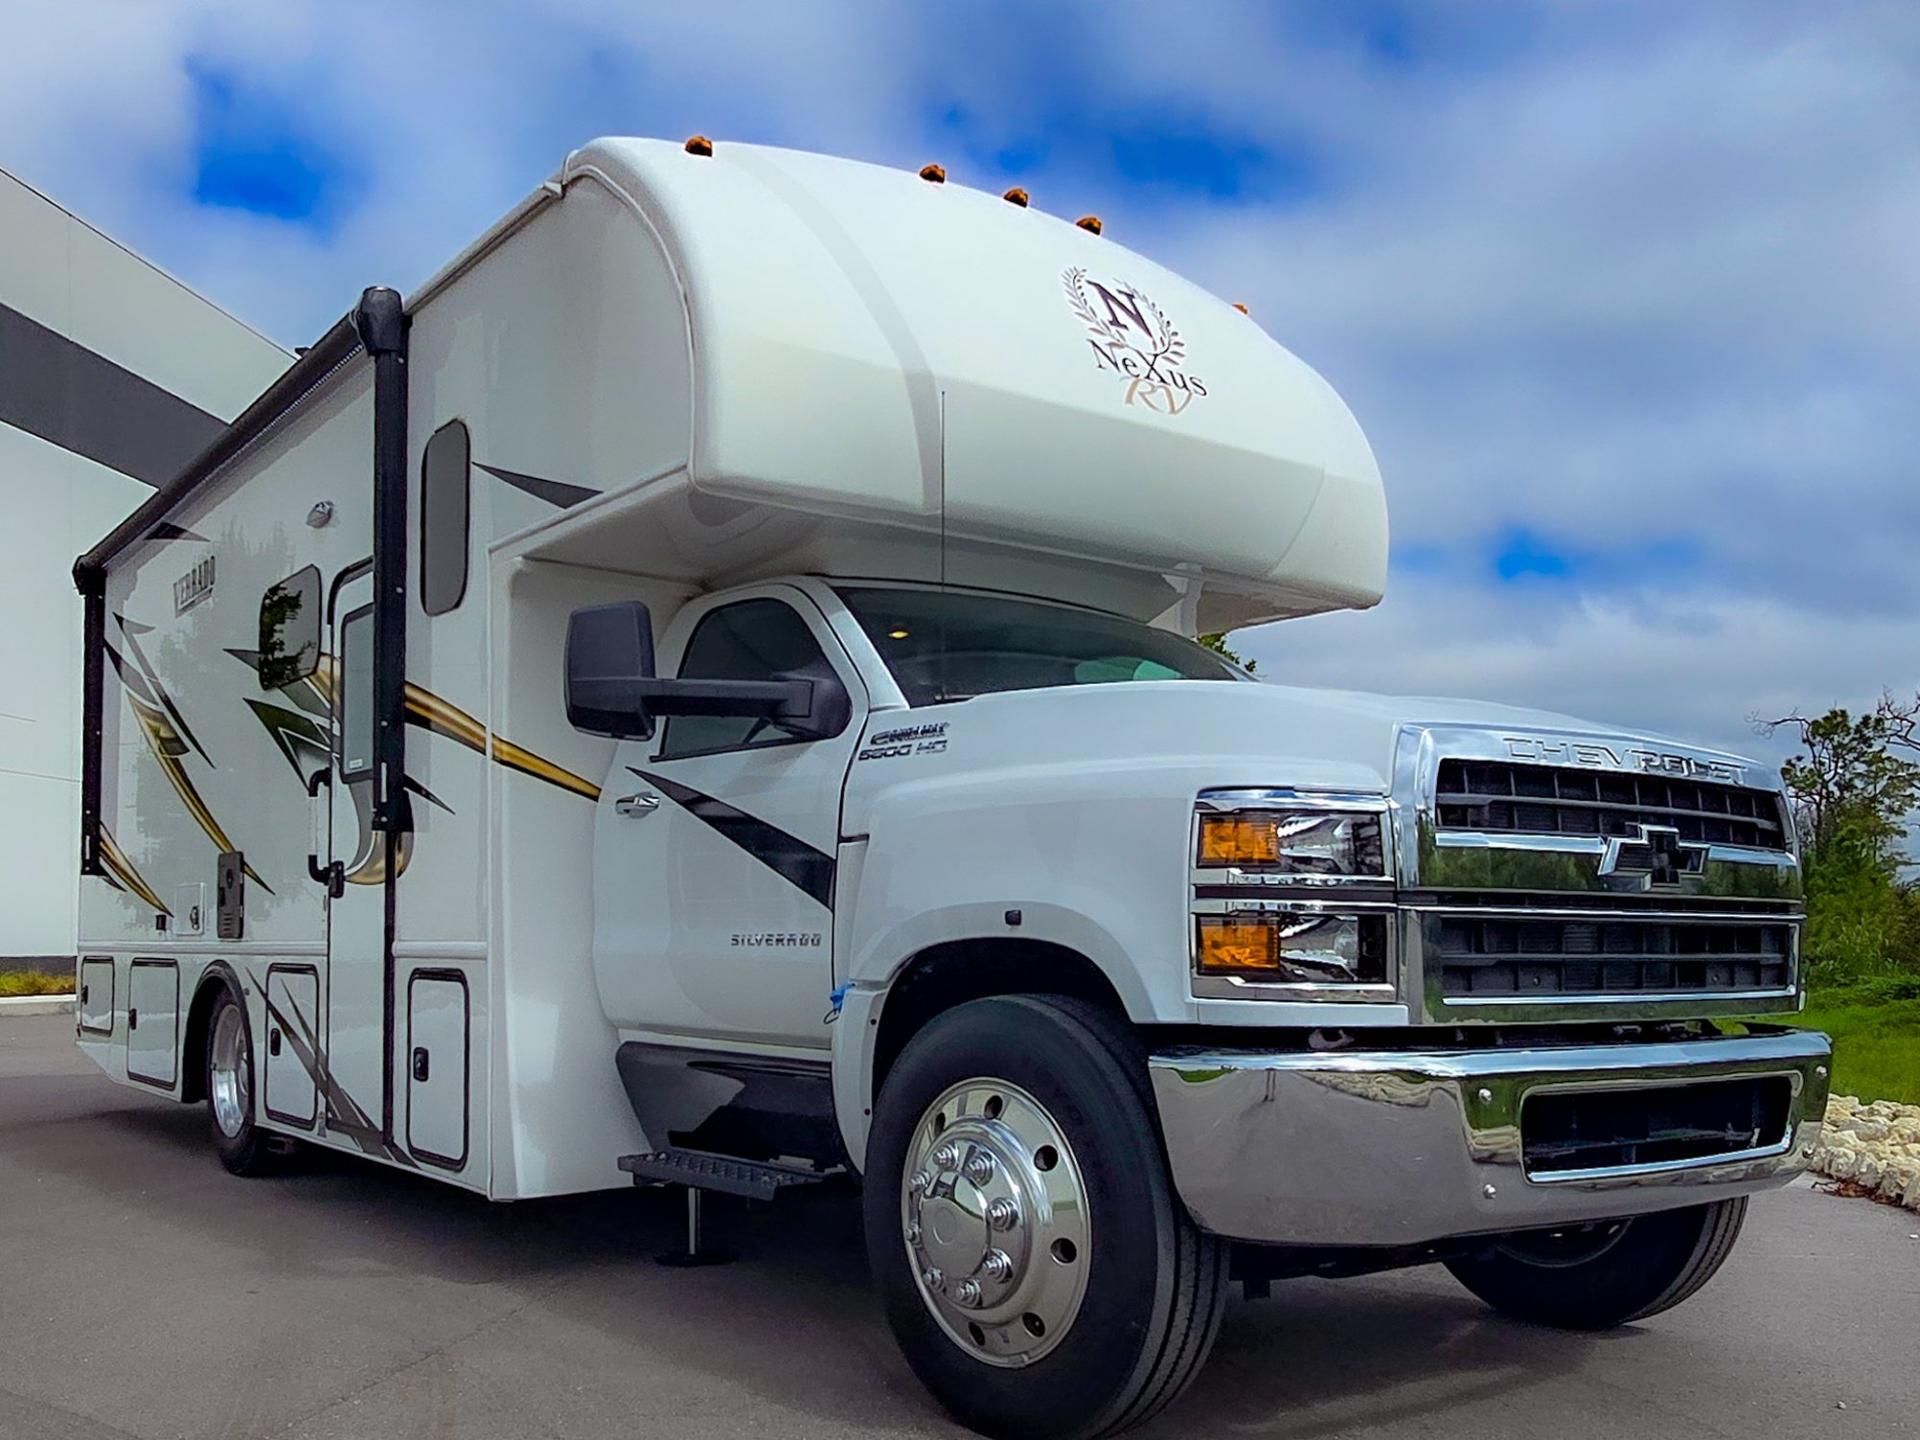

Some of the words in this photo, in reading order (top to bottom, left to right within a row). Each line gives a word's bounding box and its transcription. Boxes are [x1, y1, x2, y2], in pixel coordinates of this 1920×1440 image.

[1085, 279, 1158, 351] N
[1086, 338, 1207, 396] NeXus
[1122, 376, 1193, 415] RV
[1502, 737, 1748, 786] CHEVROLET
[731, 933, 822, 947] SILVERADO
